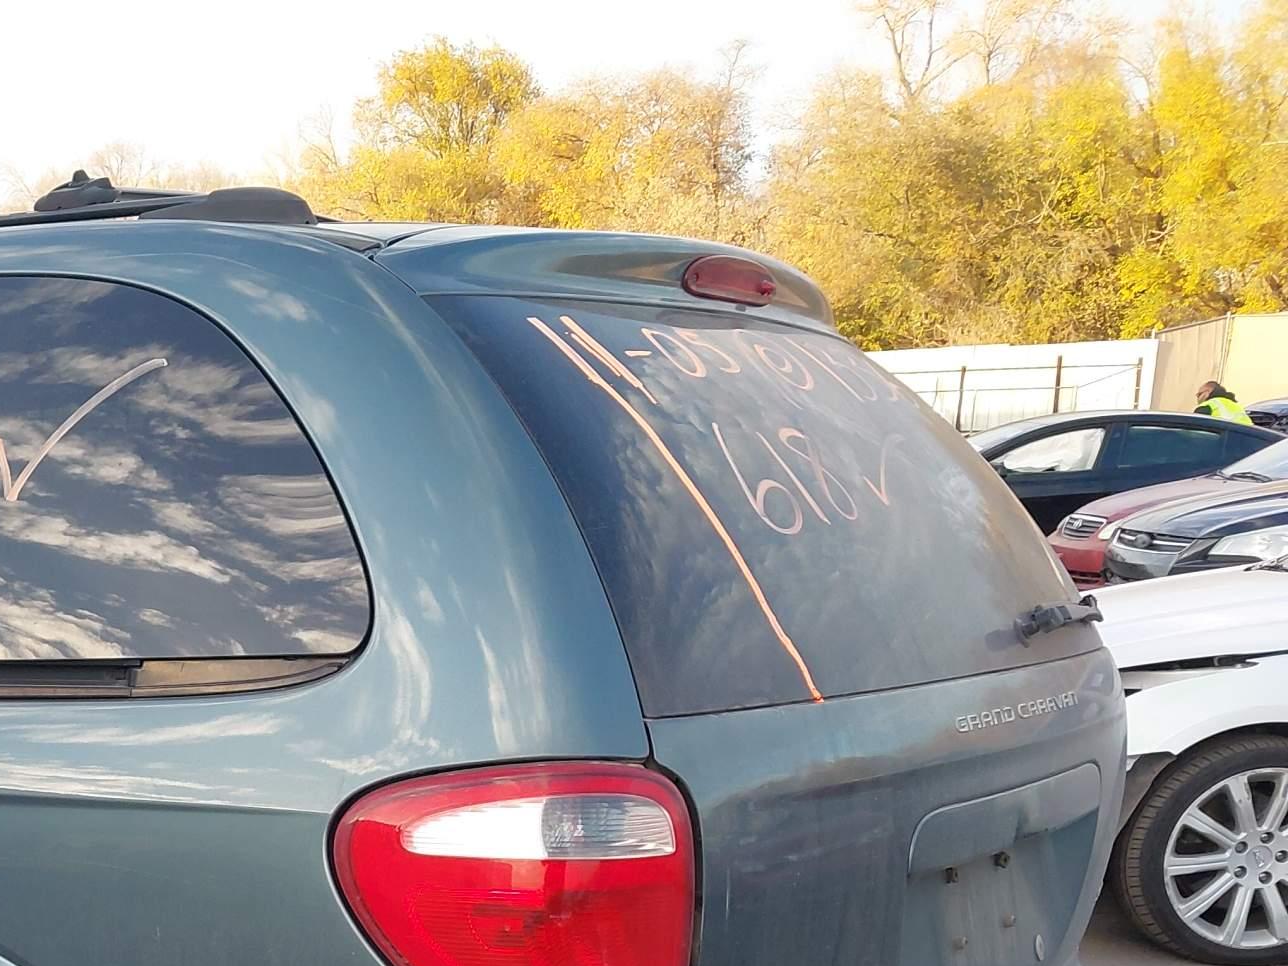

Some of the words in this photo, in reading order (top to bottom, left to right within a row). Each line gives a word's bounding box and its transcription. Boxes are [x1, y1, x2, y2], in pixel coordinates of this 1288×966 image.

[712, 422, 858, 535] 618
[955, 706, 1016, 733] GRAND
[1017, 691, 1079, 719] CARAVAN
